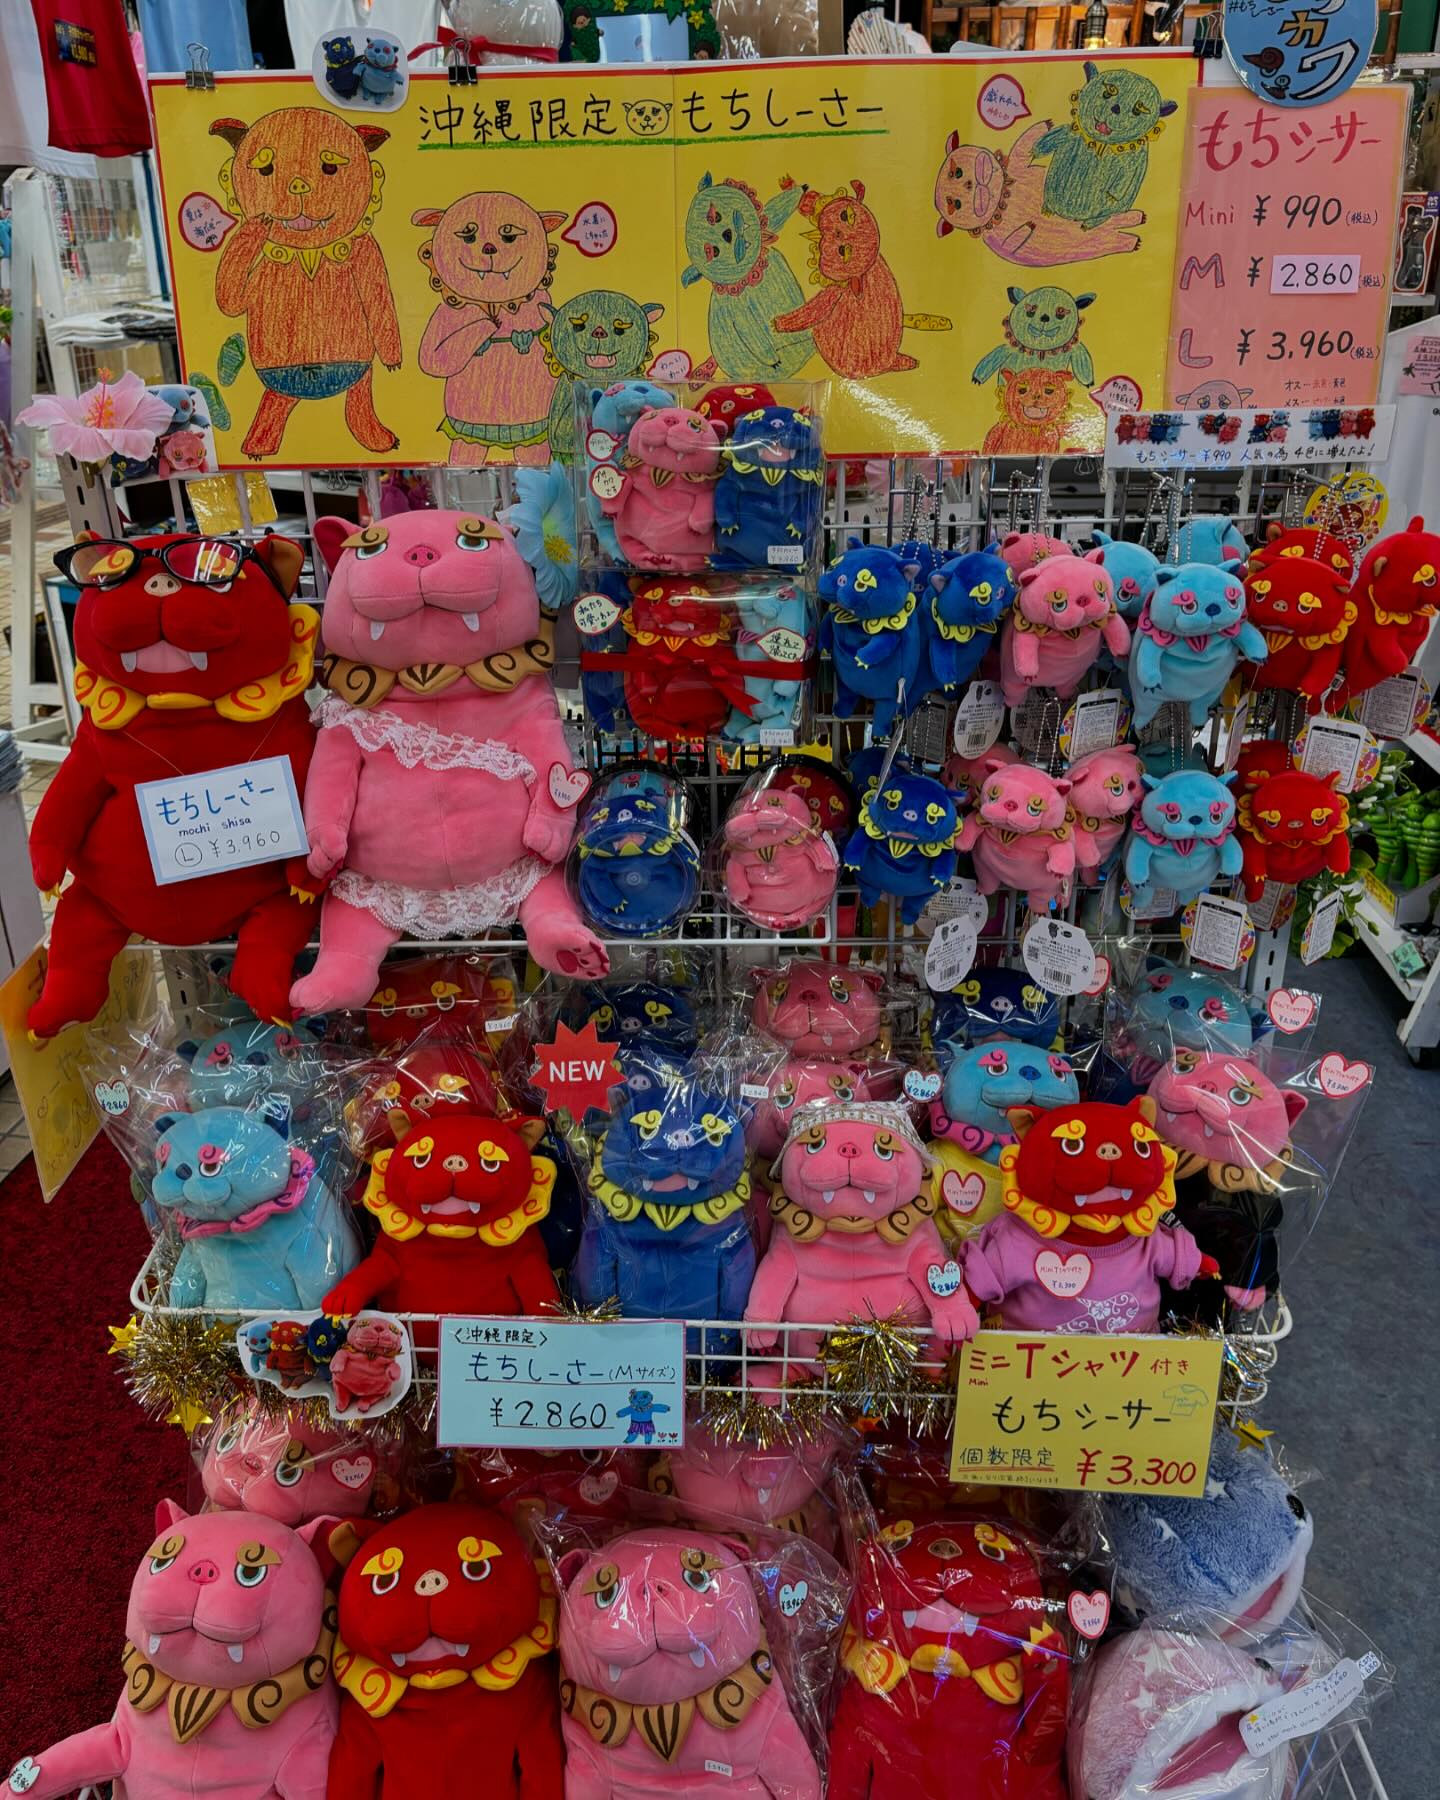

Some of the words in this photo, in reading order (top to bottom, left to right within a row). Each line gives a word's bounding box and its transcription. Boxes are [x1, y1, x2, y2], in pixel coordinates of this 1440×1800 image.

[419, 94, 617, 148] 沖縄限定
[681, 90, 884, 132] もちしーさー
[1198, 107, 1382, 171] もちシーサー
[1185, 201, 1235, 228] Mini
[1180, 252, 1226, 290] M
[1178, 327, 1214, 369] L
[155, 778, 276, 826] もちしーさー
[178, 822, 212, 838] mochi
[223, 817, 252, 831] shisa
[548, 1059, 606, 1083] NEW
[468, 1351, 604, 1385] もちしーさー
[968, 1377, 989, 1387] Mini
[991, 1396, 1172, 1434] もちシーサー
[959, 1445, 1056, 1468] 個数限定
[1076, 1448, 1197, 1487] ¥3,300
